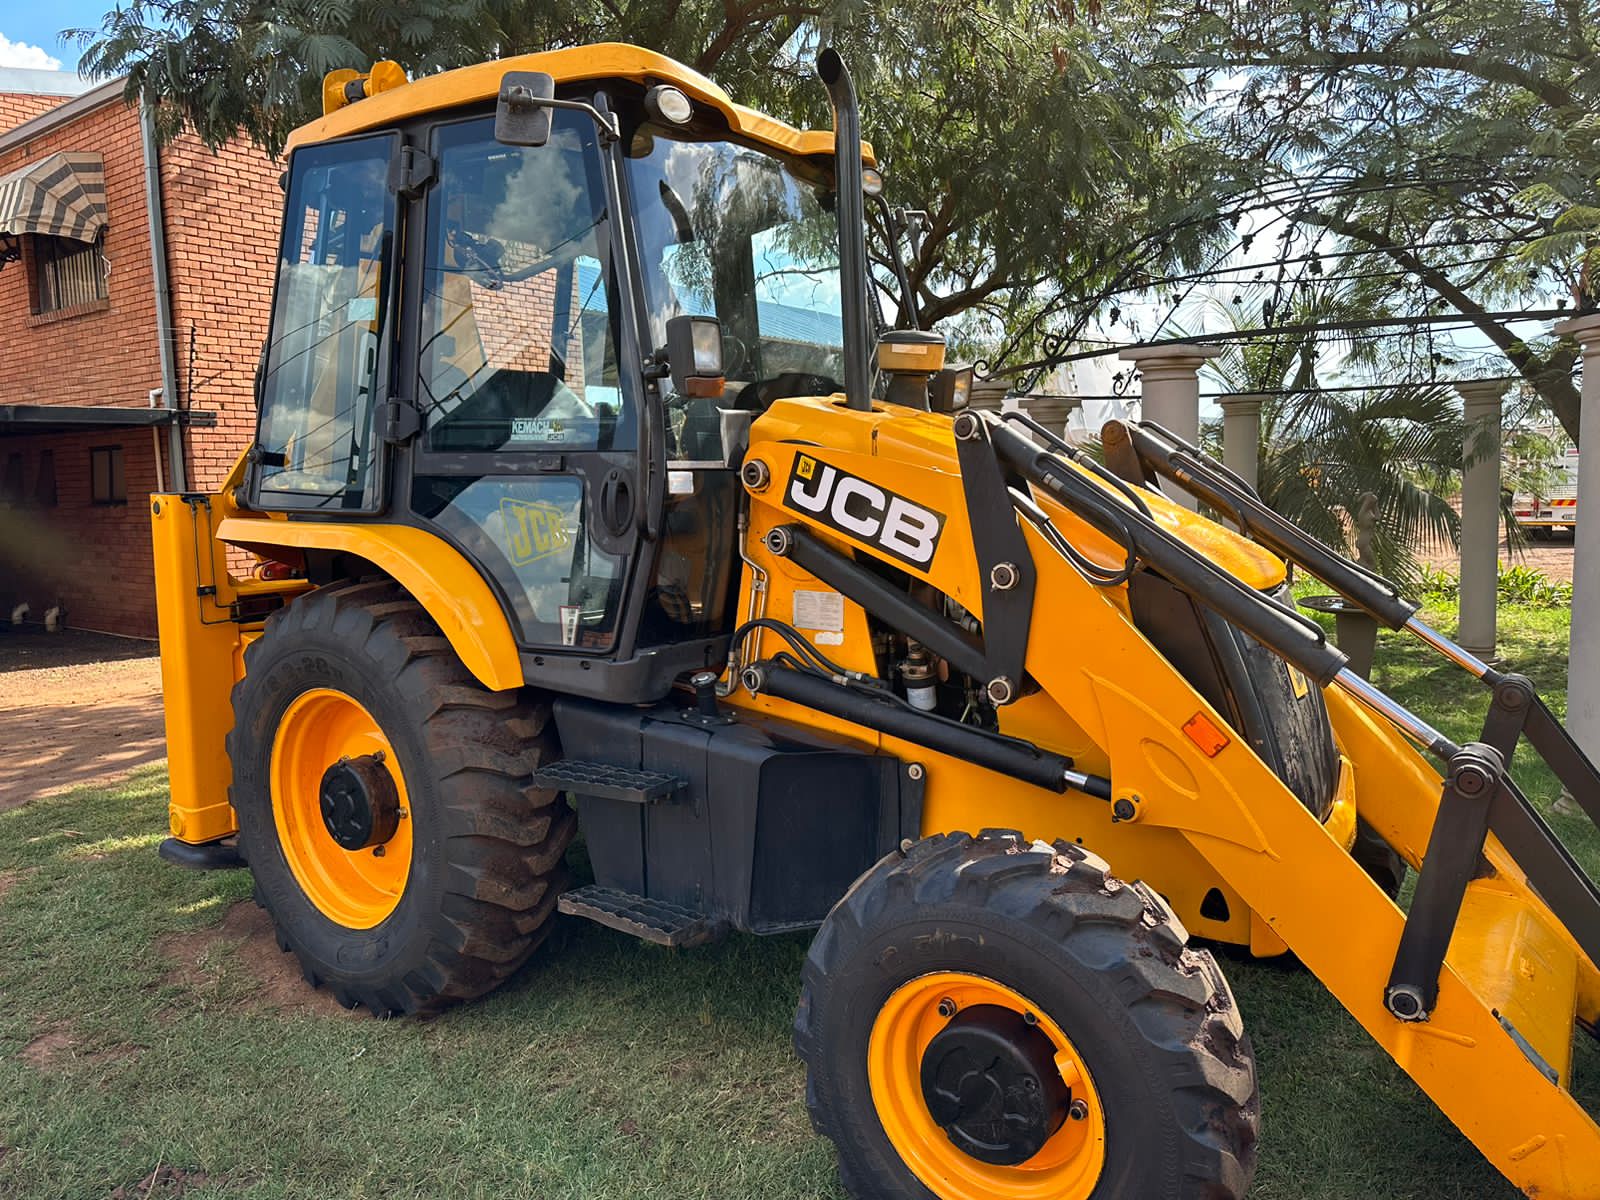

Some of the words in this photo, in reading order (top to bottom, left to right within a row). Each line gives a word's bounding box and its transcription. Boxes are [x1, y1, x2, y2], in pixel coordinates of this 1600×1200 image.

[511, 421, 550, 434] KEMACH
[511, 506, 568, 559] JCB
[790, 466, 940, 563] JCB
